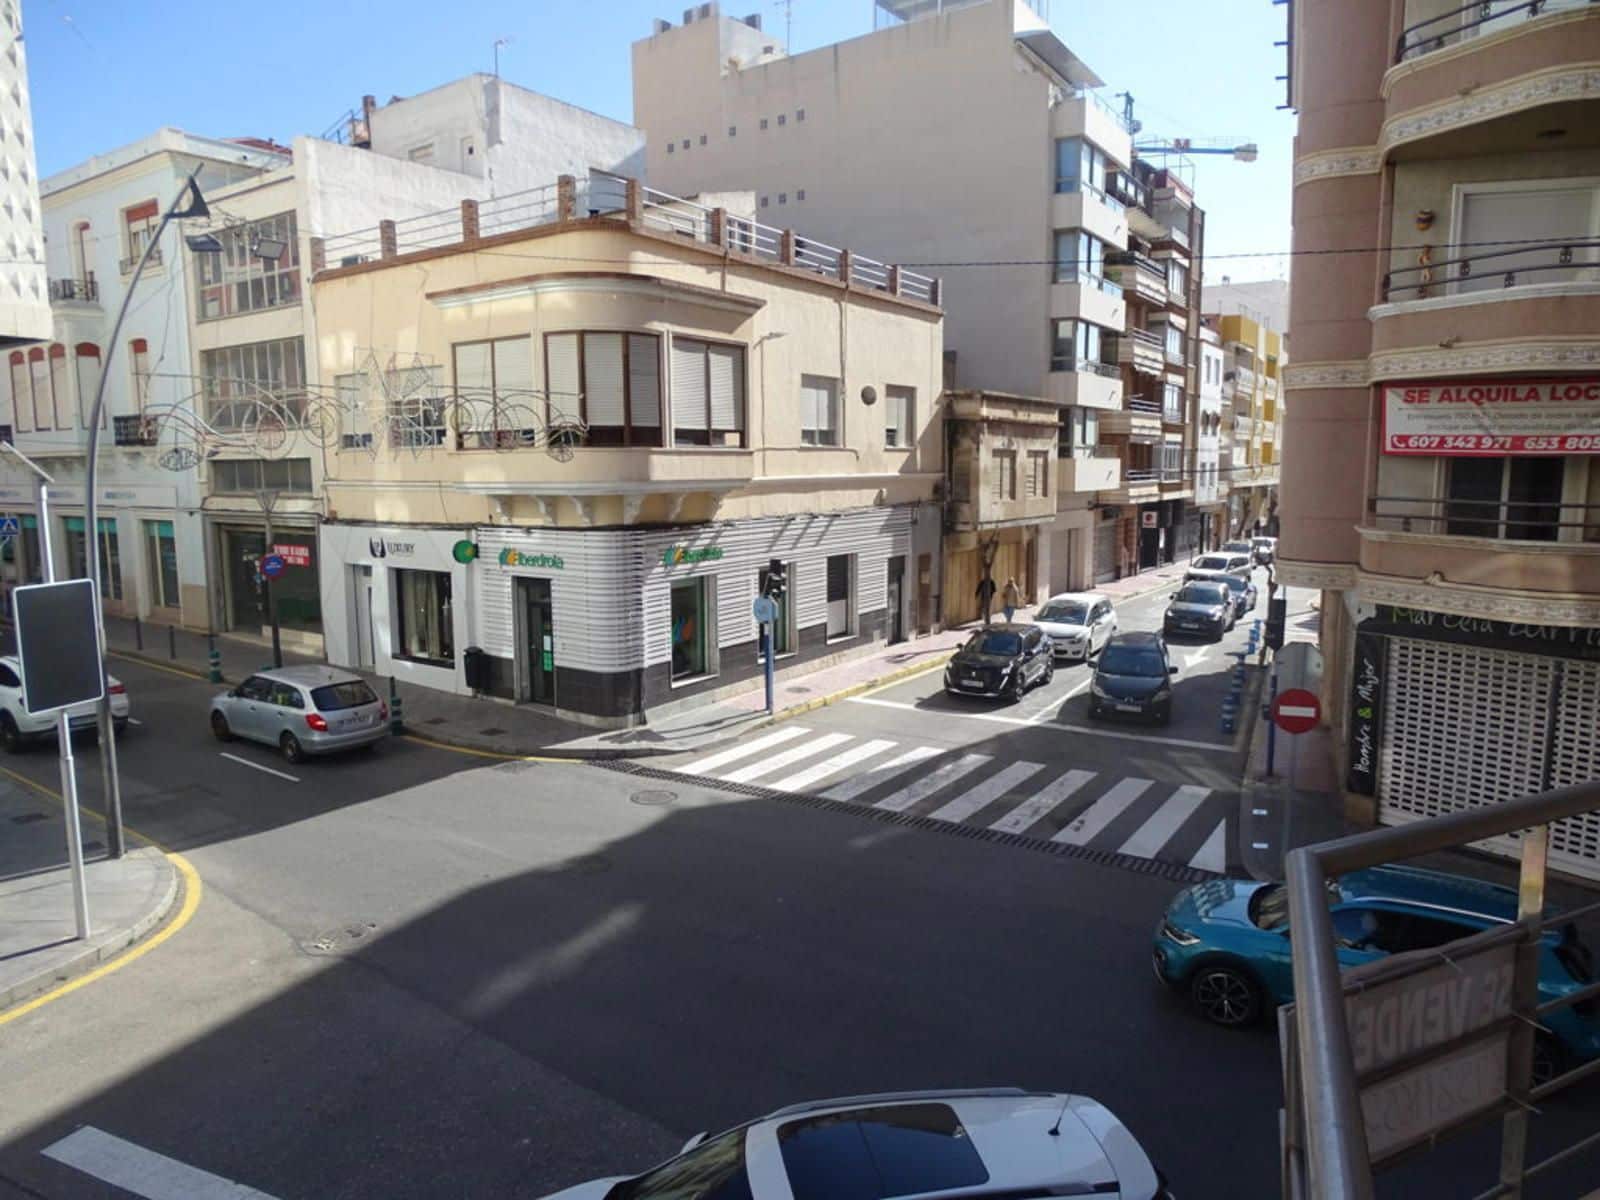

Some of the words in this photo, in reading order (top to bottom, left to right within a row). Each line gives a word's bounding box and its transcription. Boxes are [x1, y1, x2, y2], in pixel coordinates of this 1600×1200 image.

[1403, 389, 1430, 404] SE
[1437, 386, 1541, 406] ALQUILA
[1550, 384, 1600, 401] LOC
[1408, 436, 1440, 448] 607
[1524, 436, 1560, 449] 653
[1358, 706, 1372, 719] &
[1353, 724, 1371, 773] Hombre
